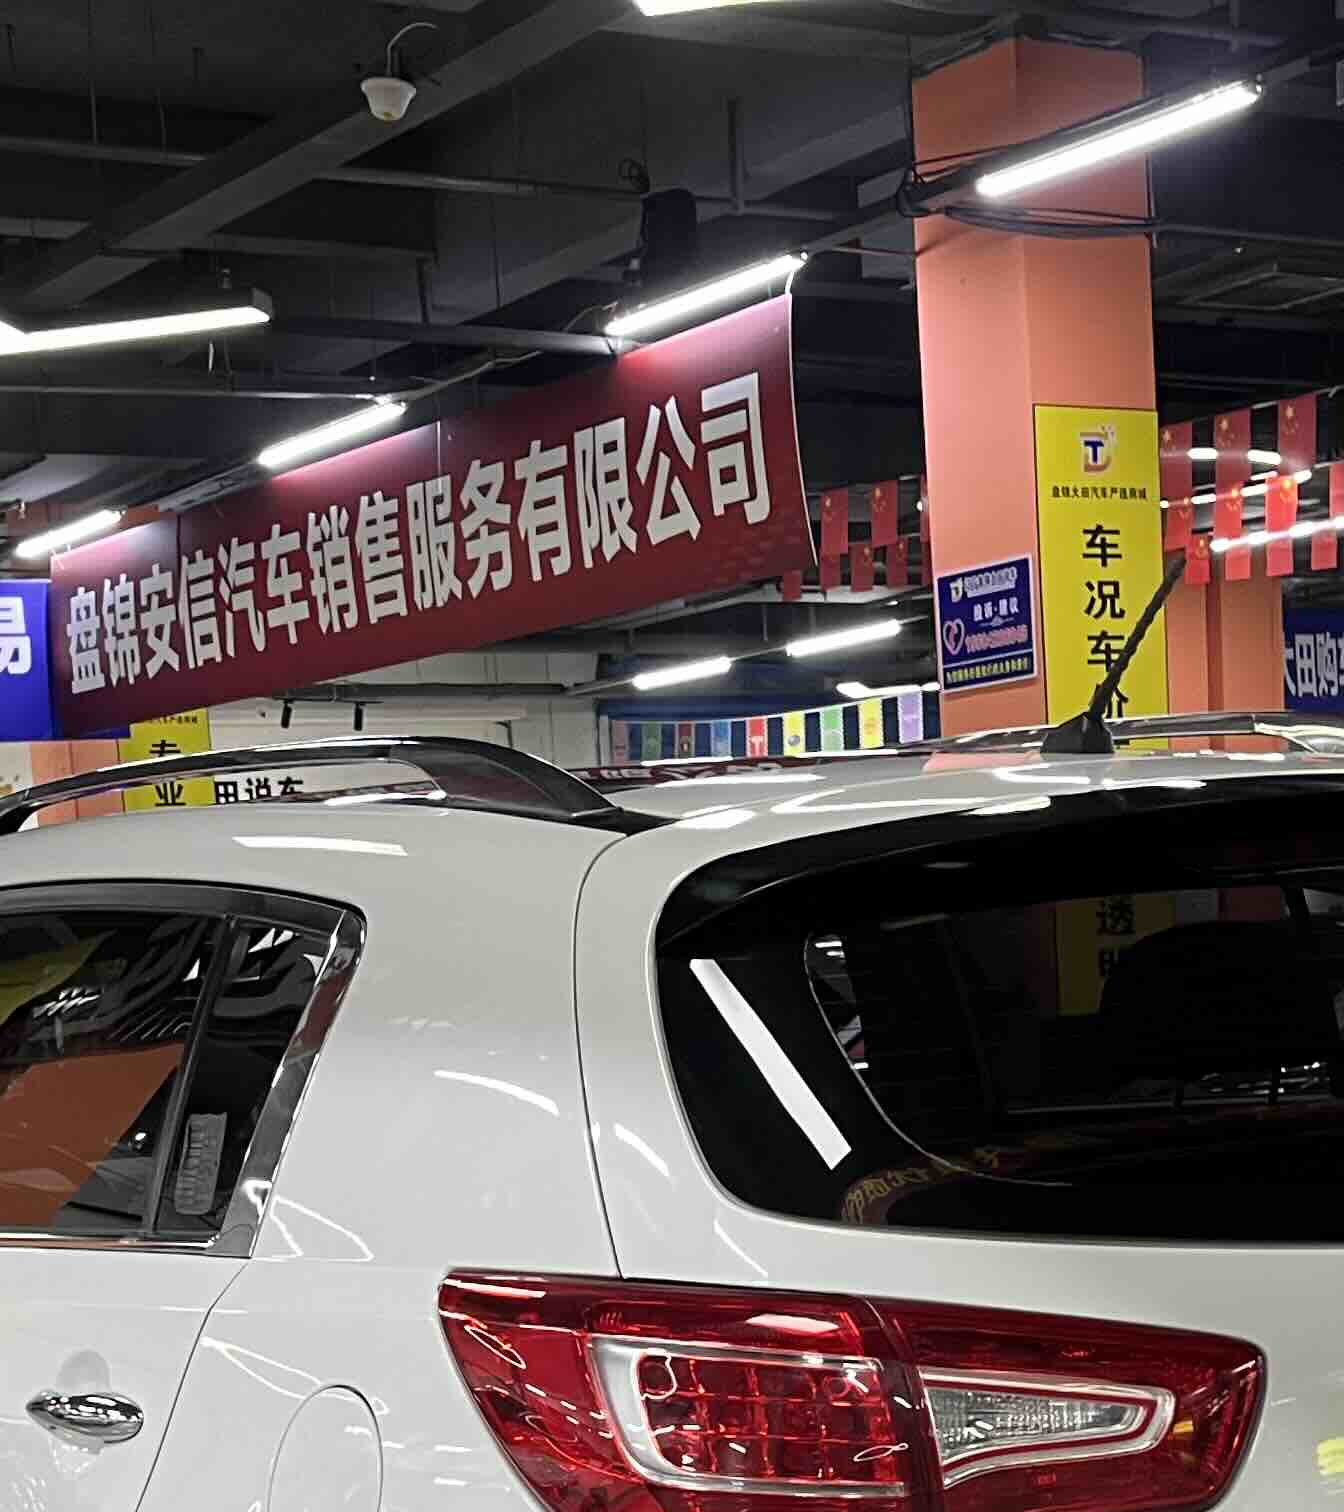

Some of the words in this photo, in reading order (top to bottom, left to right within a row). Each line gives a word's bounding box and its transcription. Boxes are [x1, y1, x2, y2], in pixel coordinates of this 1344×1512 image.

[66, 372, 771, 694] 盘锦安信汽车销售服务有限公司
